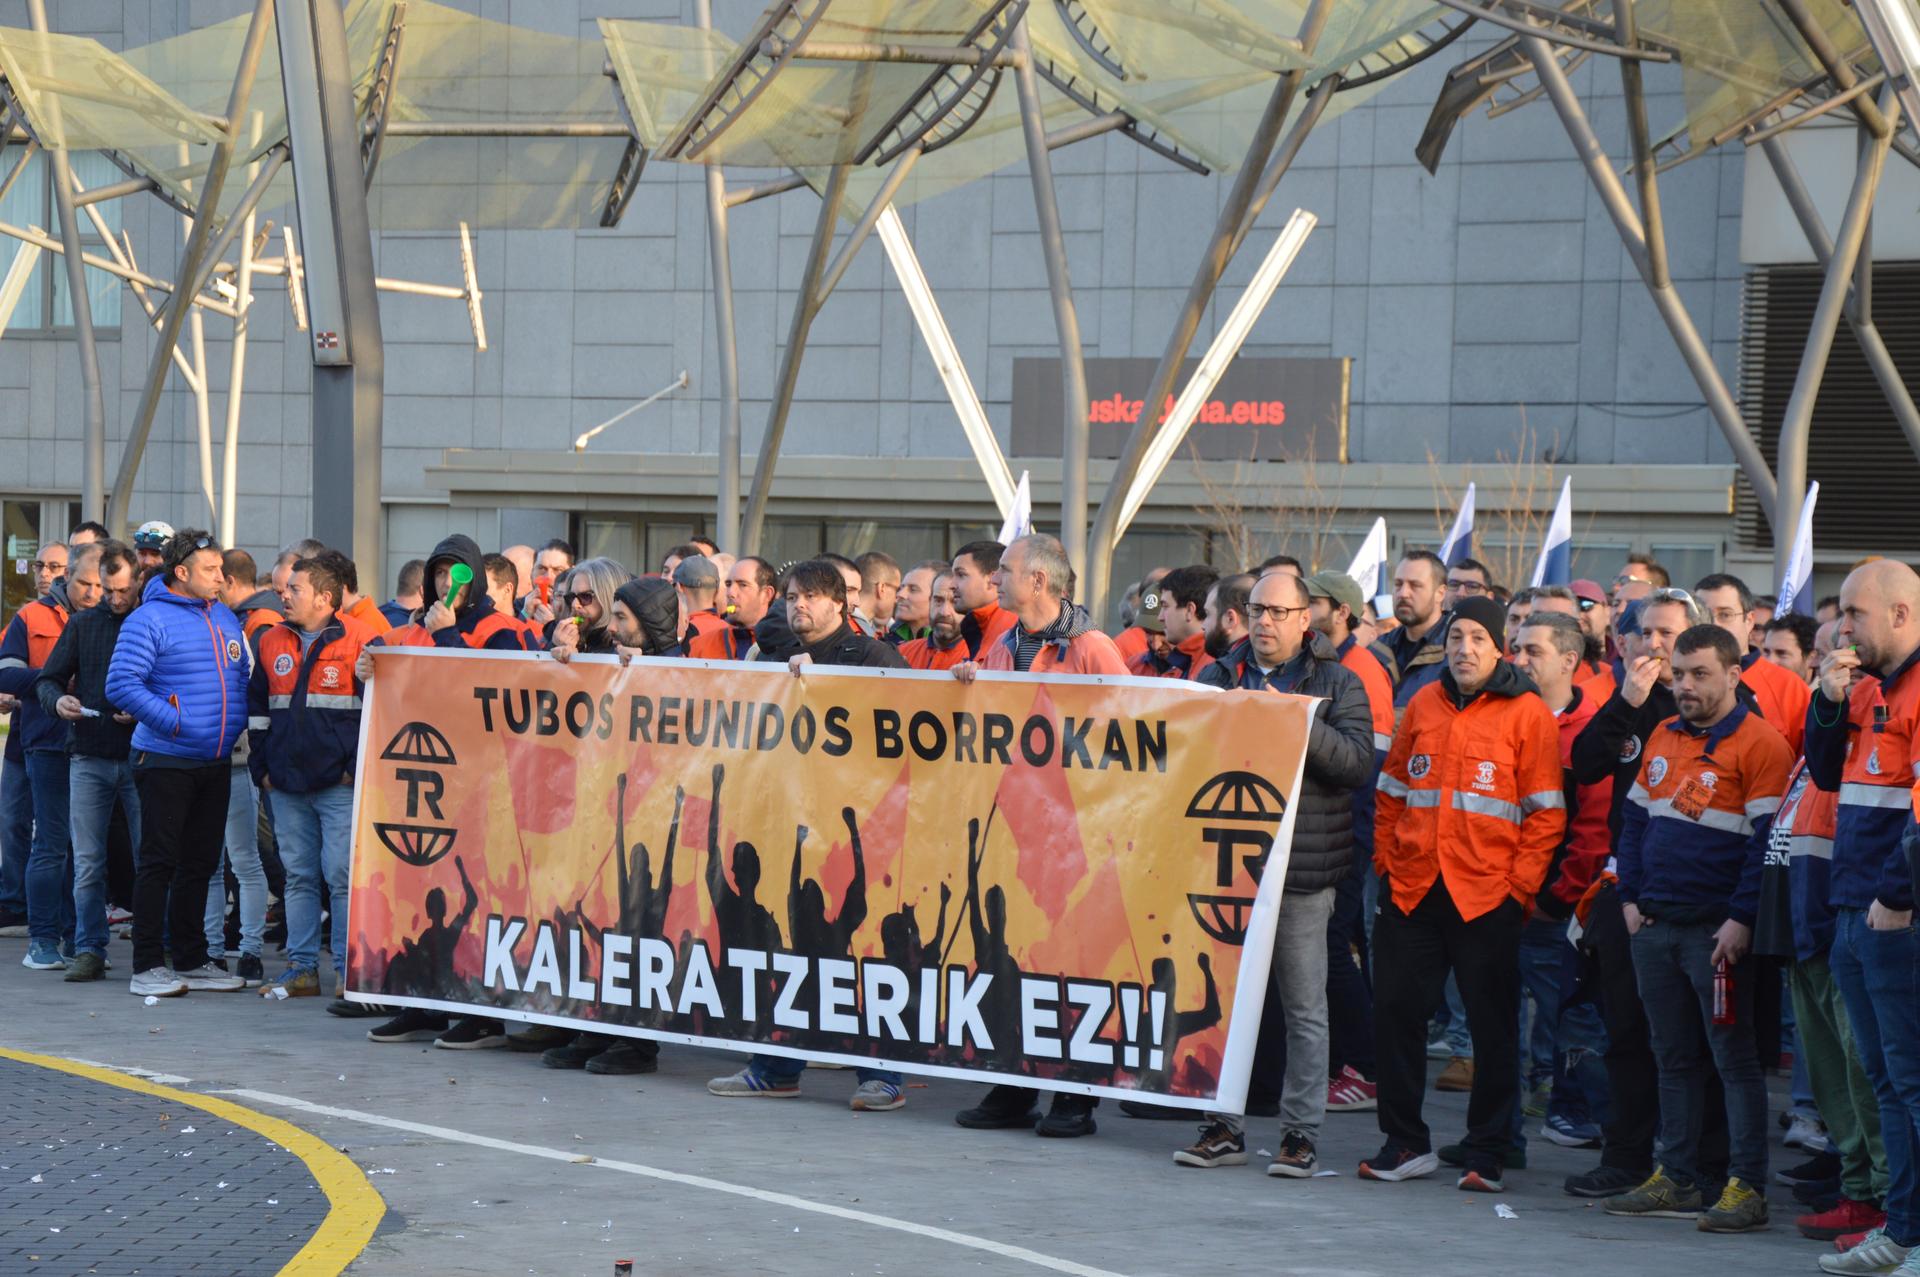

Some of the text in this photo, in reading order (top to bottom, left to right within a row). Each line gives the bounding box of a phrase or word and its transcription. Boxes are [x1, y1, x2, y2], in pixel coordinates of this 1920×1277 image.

[474, 687, 1167, 773] TUBOS REUNIDOS BORROKAN
[395, 768, 446, 820] TR
[483, 919, 1168, 1072] KALERATZERIK EZ!!
